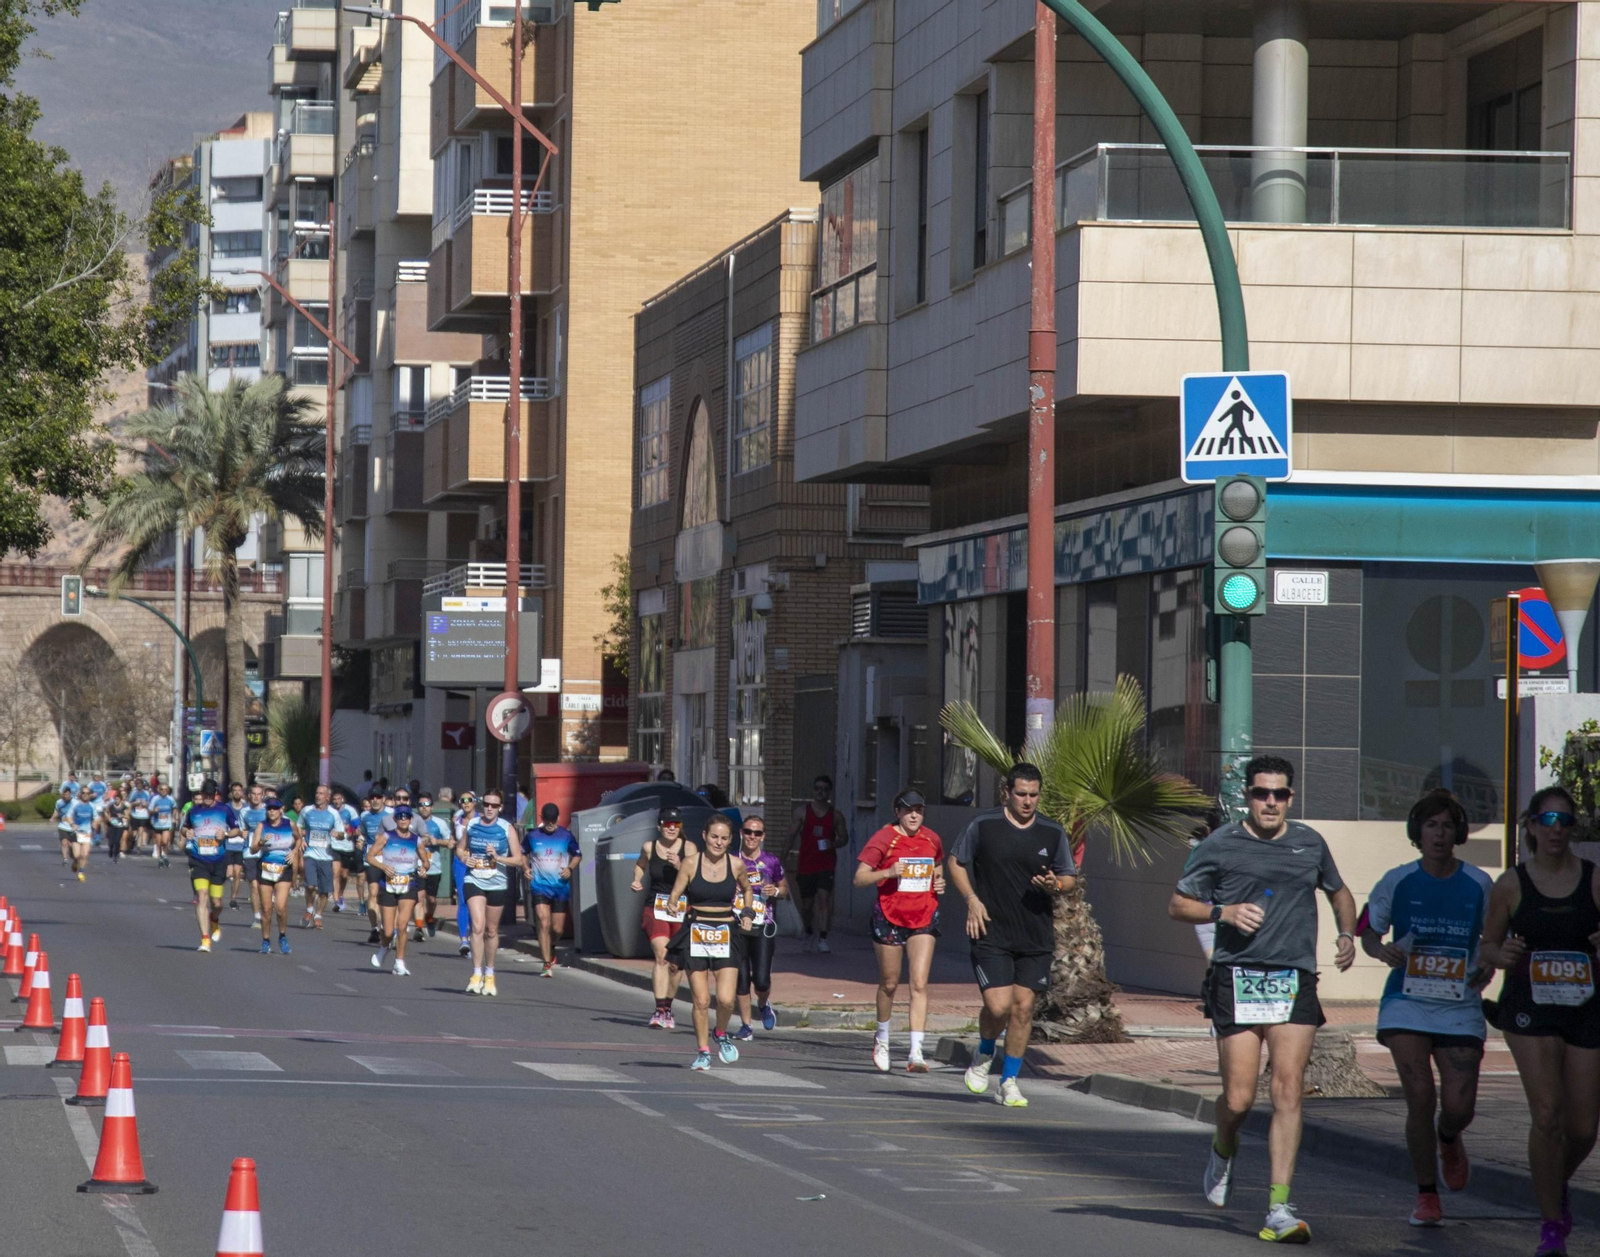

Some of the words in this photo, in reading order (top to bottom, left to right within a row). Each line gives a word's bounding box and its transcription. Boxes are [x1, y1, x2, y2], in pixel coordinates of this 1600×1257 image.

[1281, 588, 1322, 600] ALBACETE
[907, 864, 928, 875] 164
[700, 930, 722, 941] 165
[1447, 926, 1470, 936] 2025
[1414, 956, 1462, 974] 1927
[1538, 961, 1586, 979] 1095
